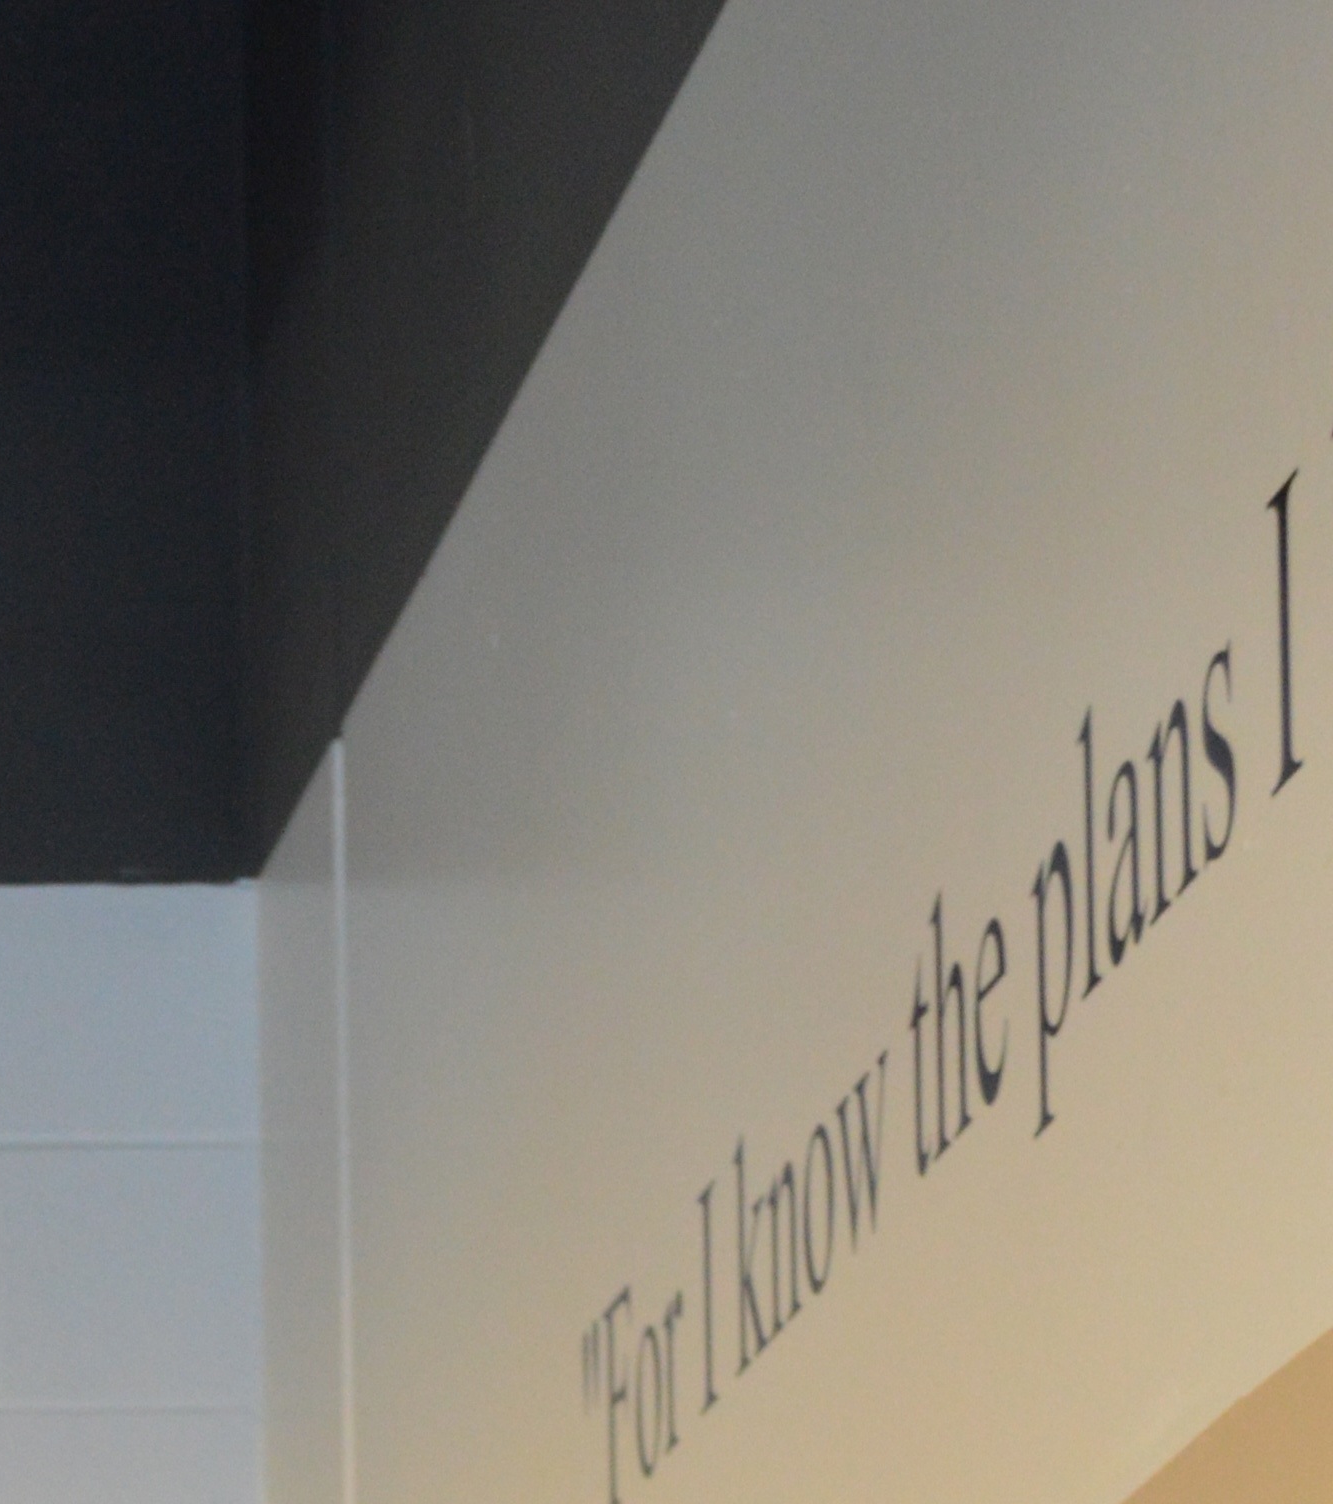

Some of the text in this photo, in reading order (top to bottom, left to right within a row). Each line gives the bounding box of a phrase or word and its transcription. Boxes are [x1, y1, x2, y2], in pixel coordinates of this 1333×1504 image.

[694, 1177, 719, 1416] I
[733, 1047, 890, 1378] know
[909, 887, 1009, 1179] the
[1030, 638, 1237, 1140] plans
[1265, 467, 1305, 799] I
